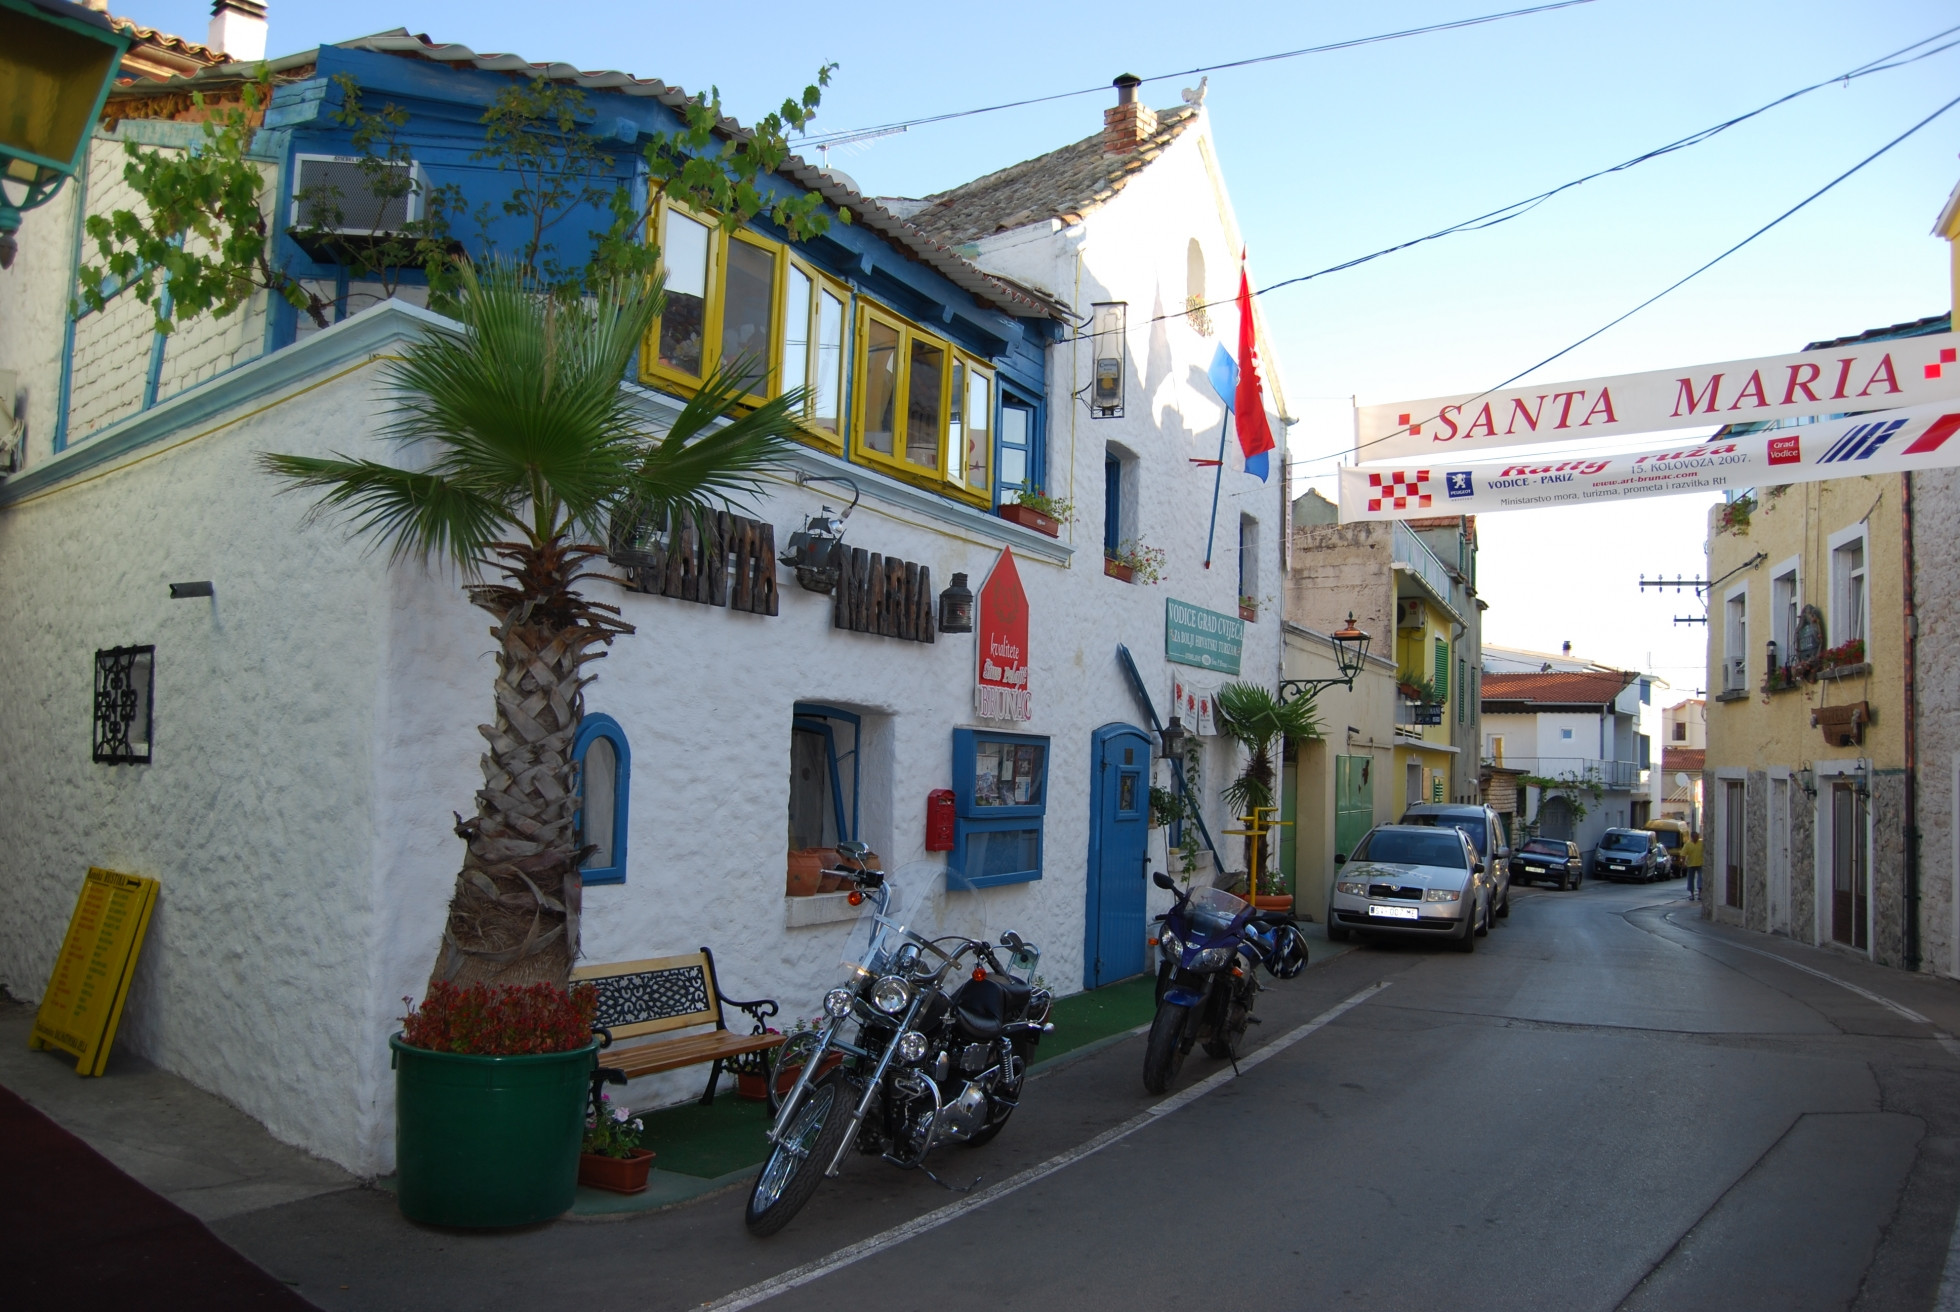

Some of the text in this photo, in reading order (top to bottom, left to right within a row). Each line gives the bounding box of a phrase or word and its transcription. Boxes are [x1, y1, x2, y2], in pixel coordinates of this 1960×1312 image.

[1433, 353, 1904, 442] SANTA MARIA
[1770, 449, 1798, 459] Vodice
[1773, 440, 1795, 449] Grad
[1632, 454, 1751, 474] 15. KOLOVOZA 2007.
[1488, 477, 1529, 490] VODICE
[1500, 495, 1551, 506] Ministarstvo
[1554, 493, 1580, 503] mora,
[1583, 488, 1620, 499] turizma,
[1623, 484, 1663, 496] prometa
[1671, 478, 1710, 490] razvitka
[1713, 476, 1727, 486] RH
[1592, 472, 1698, 487] www.art-brunac.com
[835, 543, 934, 643] MARIA
[1168, 603, 1243, 641] VODICE GRAD CVIJEĆA
[990, 632, 1020, 659] kvalitete
